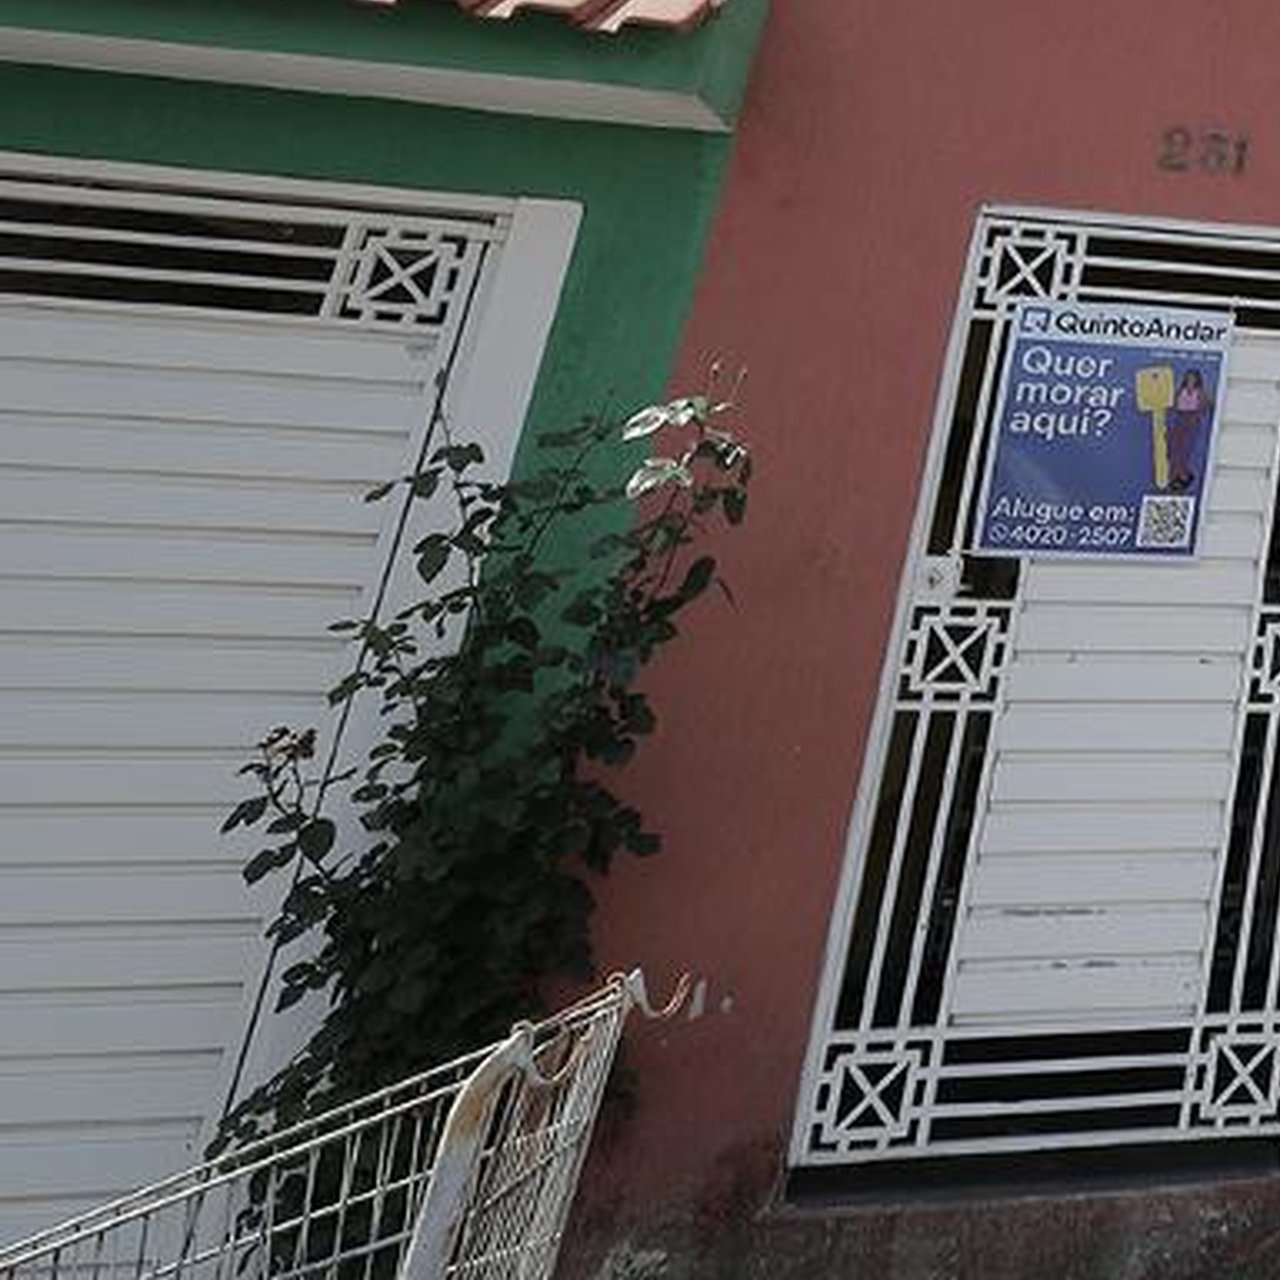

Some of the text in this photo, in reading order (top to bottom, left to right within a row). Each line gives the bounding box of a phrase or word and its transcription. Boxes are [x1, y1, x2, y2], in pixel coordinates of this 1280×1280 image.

[1055, 311, 1227, 341] QuintoAndar
[1022, 346, 1113, 378] Quer
[1015, 381, 1124, 408] morar
[1009, 409, 1112, 440] aqui?
[991, 497, 1135, 524] Alugue em:
